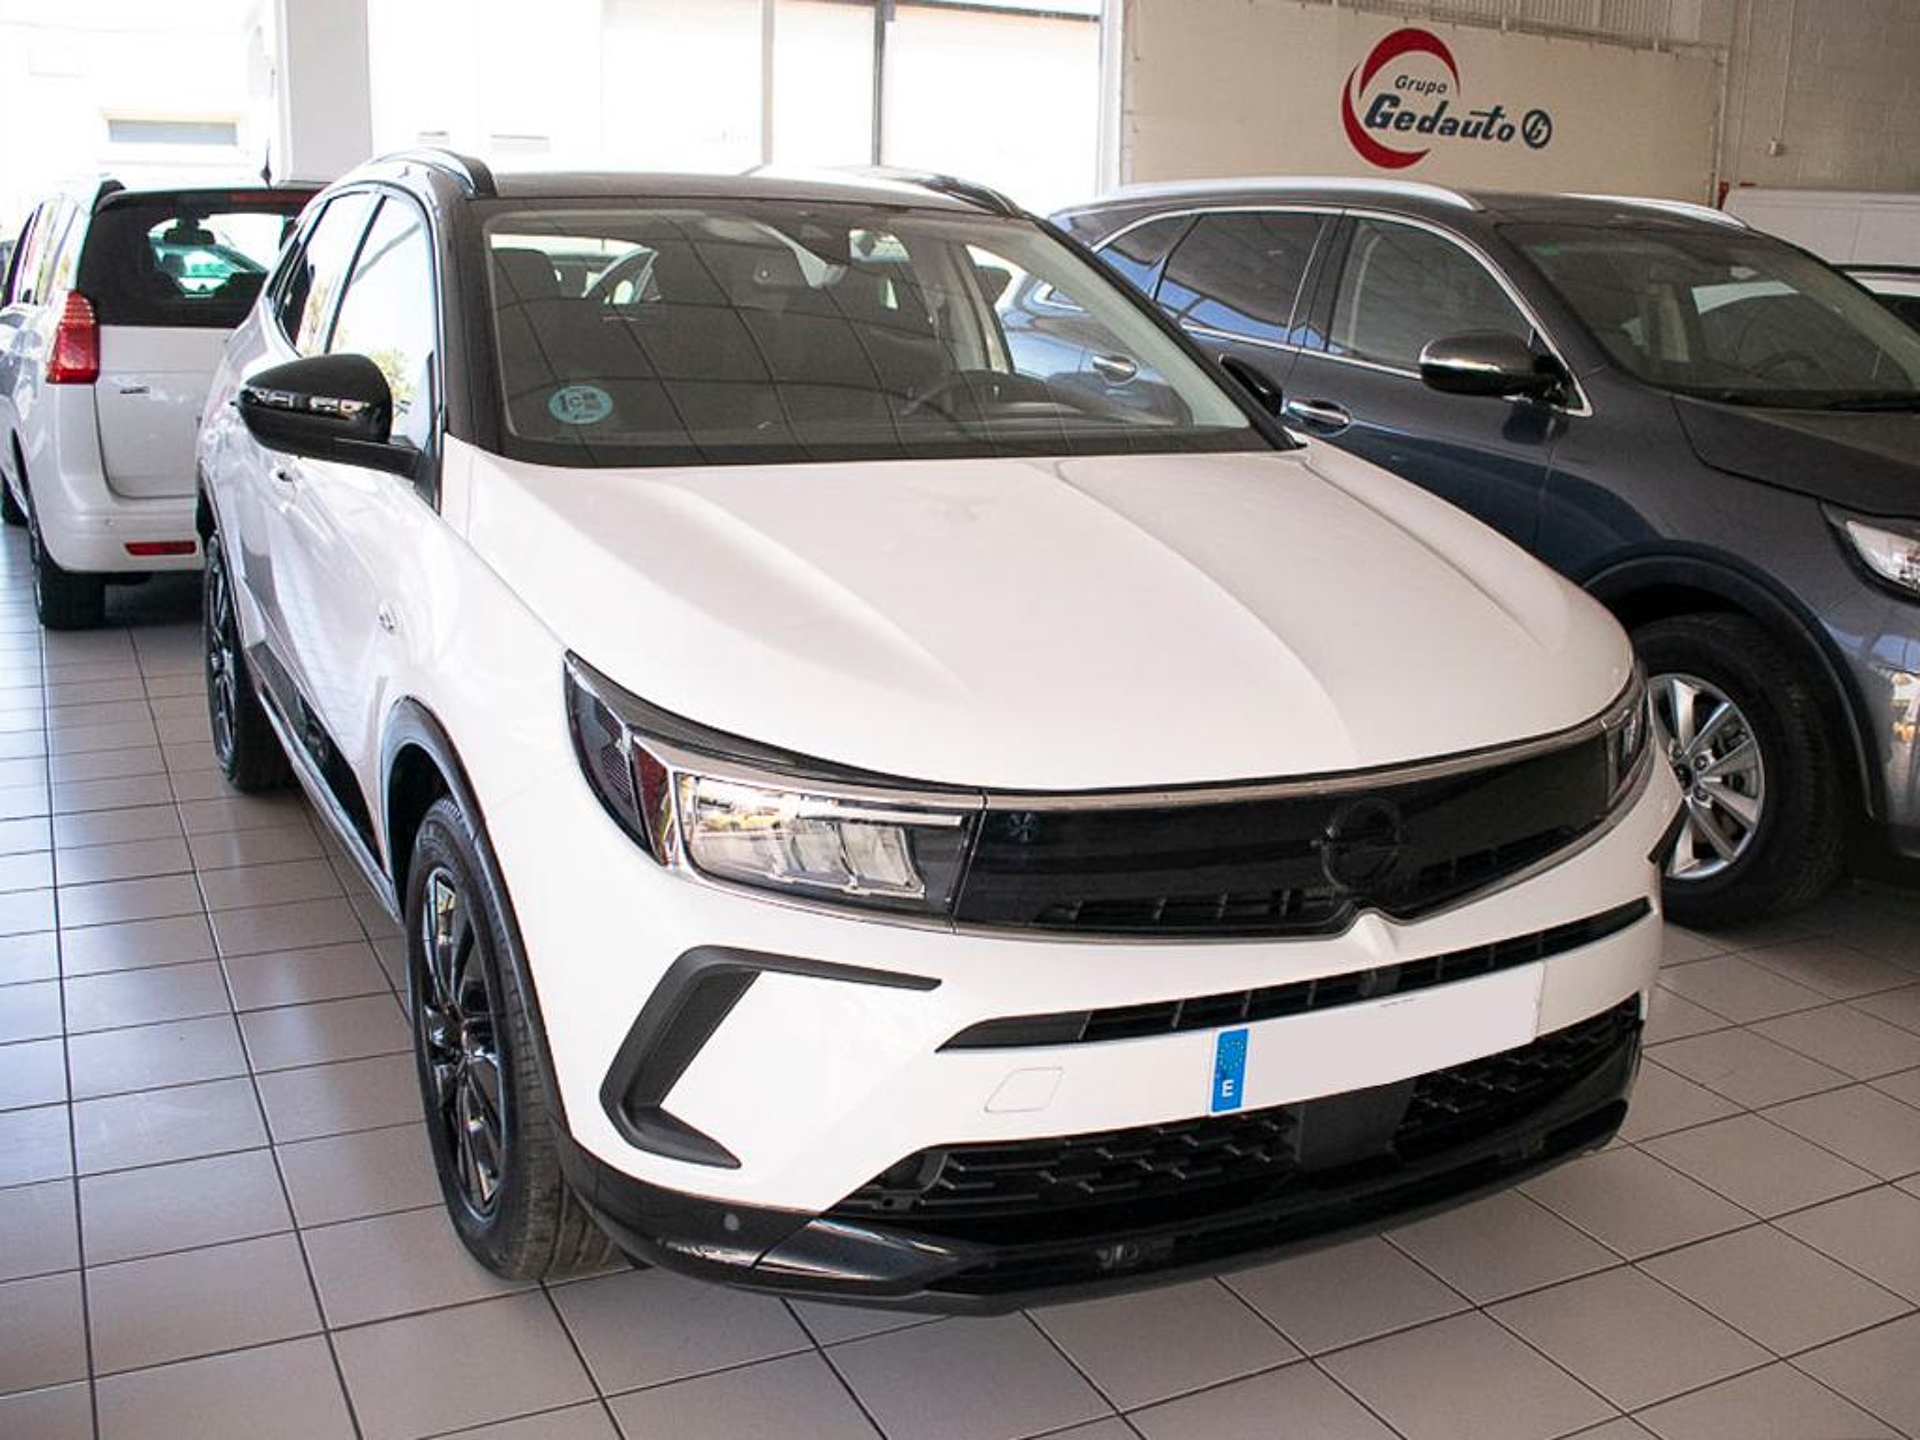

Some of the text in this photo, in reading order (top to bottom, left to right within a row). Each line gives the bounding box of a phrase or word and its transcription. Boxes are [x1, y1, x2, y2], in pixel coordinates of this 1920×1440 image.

[1395, 75, 1447, 95] Grupo
[1364, 93, 1516, 142] Gedauto
[1222, 1080, 1234, 1097] E
